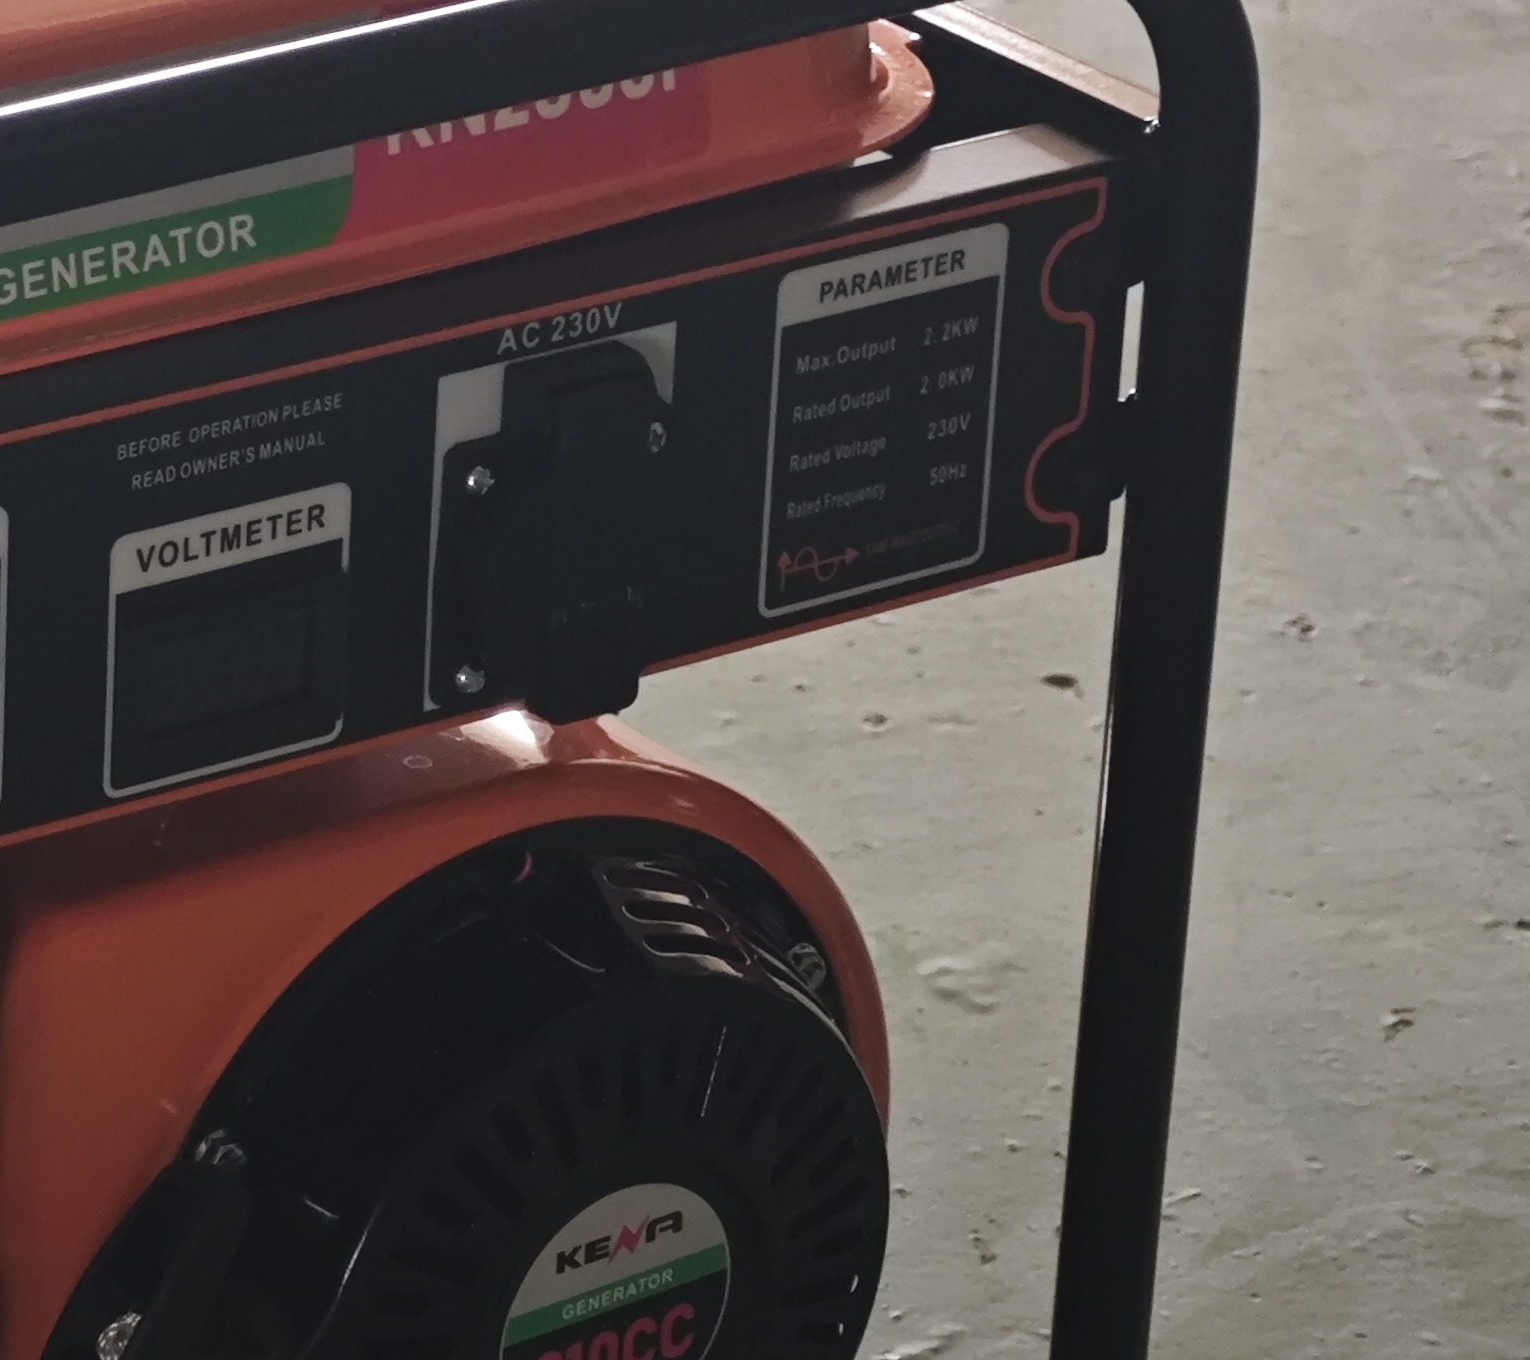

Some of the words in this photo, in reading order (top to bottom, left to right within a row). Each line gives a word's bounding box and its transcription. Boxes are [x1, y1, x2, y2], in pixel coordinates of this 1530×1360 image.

[819, 249, 966, 304] PARAMETER
[497, 321, 541, 355] AC
[551, 301, 623, 343] 230V
[117, 430, 182, 461] BEFORE
[188, 408, 279, 444] OPERATION
[282, 392, 343, 421] PLEASE
[792, 397, 837, 423] Rated
[839, 385, 891, 413] Output
[131, 466, 176, 491] READ
[180, 446, 255, 480] OWNER'S
[259, 430, 326, 459] MANUAL
[789, 449, 831, 473] Rated
[834, 436, 887, 461] Voltage
[927, 413, 970, 440] 230V
[786, 498, 821, 520] Rated
[823, 483, 887, 510] Frequency
[929, 463, 968, 486] 50Hz
[136, 503, 326, 573] VOLTMETER
[555, 1210, 683, 1275] KENA
[562, 1268, 674, 1321] GENERATOR
